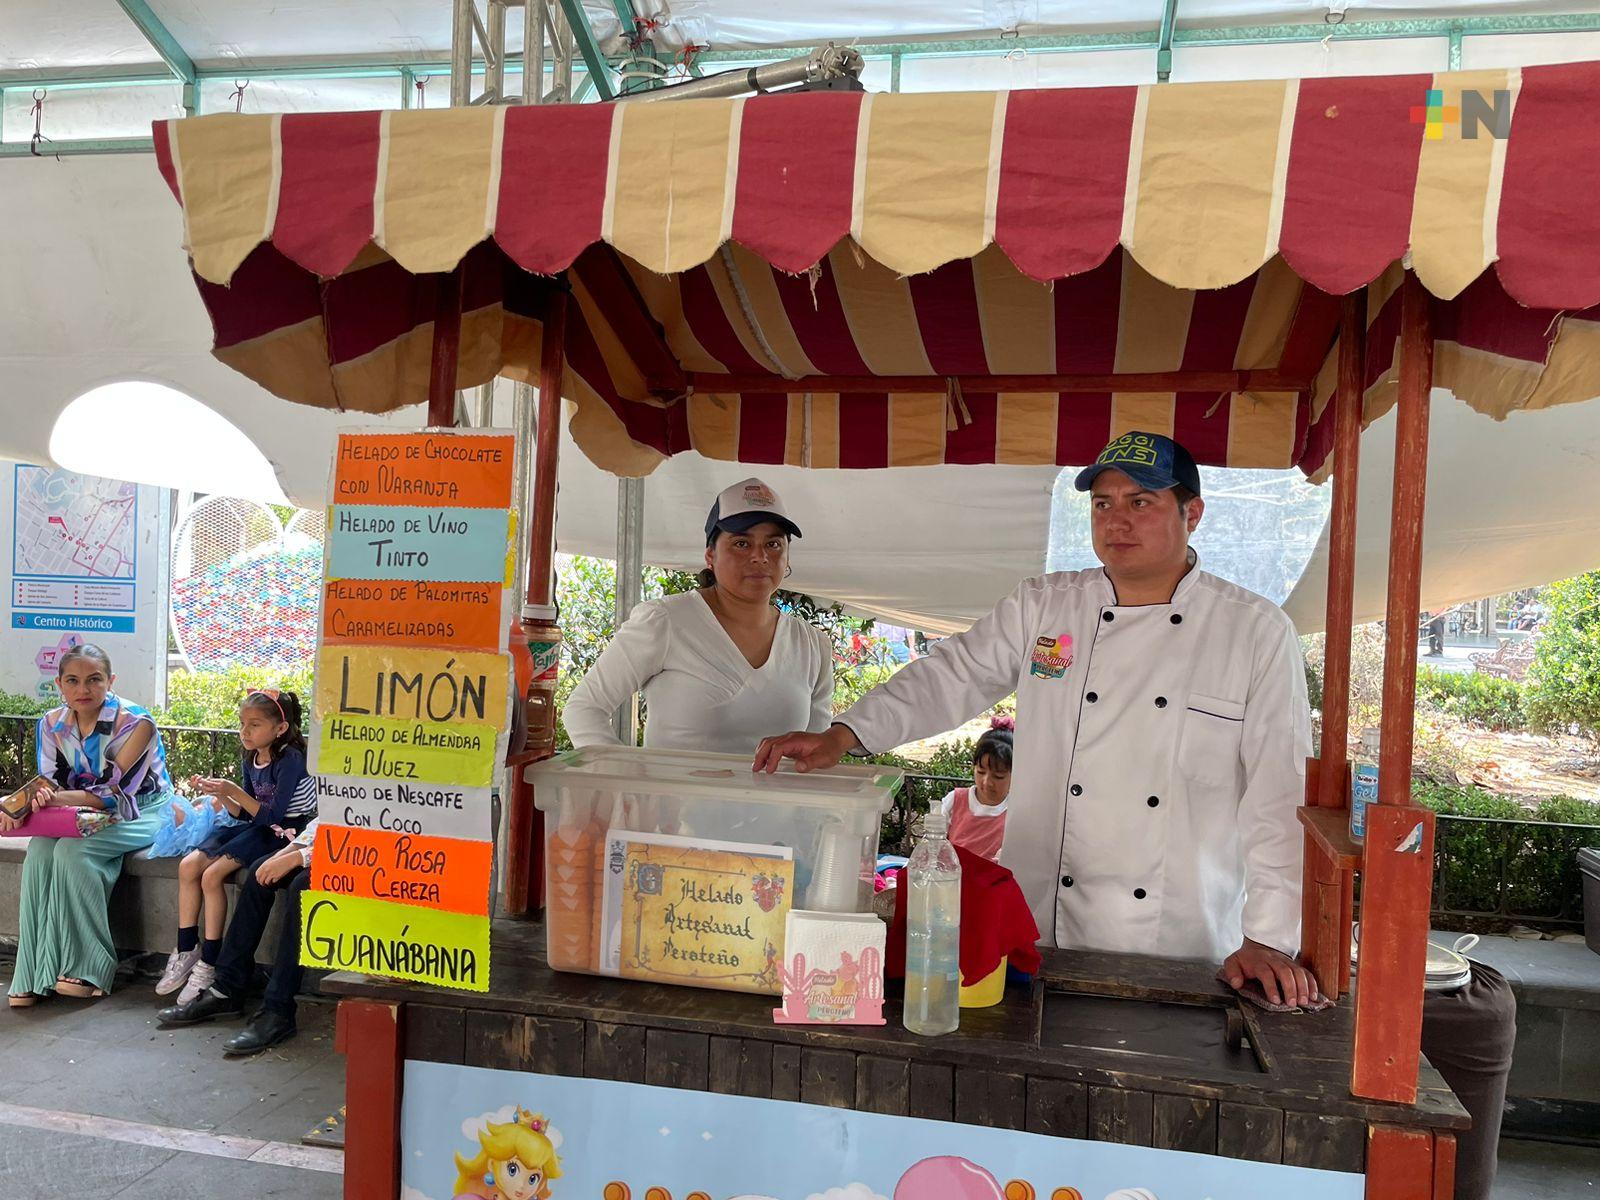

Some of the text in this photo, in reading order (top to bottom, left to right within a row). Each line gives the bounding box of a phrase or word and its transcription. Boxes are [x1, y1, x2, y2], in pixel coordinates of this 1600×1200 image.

[341, 439, 399, 461] HELADO
[424, 438, 502, 463] CHOCOLATE
[378, 464, 459, 499] NARANJA
[339, 510, 468, 535] HELADO DE VINO
[368, 538, 429, 567] TINTO
[326, 580, 383, 600] HELADO
[414, 581, 490, 604] PALOMITAS
[33, 615, 113, 630] Centro Histórico
[331, 608, 455, 638] CARAMELIZADAS
[339, 655, 487, 723] LIMÓN
[329, 718, 481, 751] HELADO DE ALMENDRA
[362, 748, 419, 779] NUEZ
[317, 776, 464, 810] HELADO DE NESCAFE
[379, 807, 422, 835] COCO
[326, 829, 446, 876] VINO ROSA
[371, 867, 440, 903] CEREZA
[678, 878, 743, 906] Helado
[664, 902, 755, 941] Artesanal
[305, 899, 477, 984] GUANÁBANA
[663, 936, 740, 968] Peroteño
